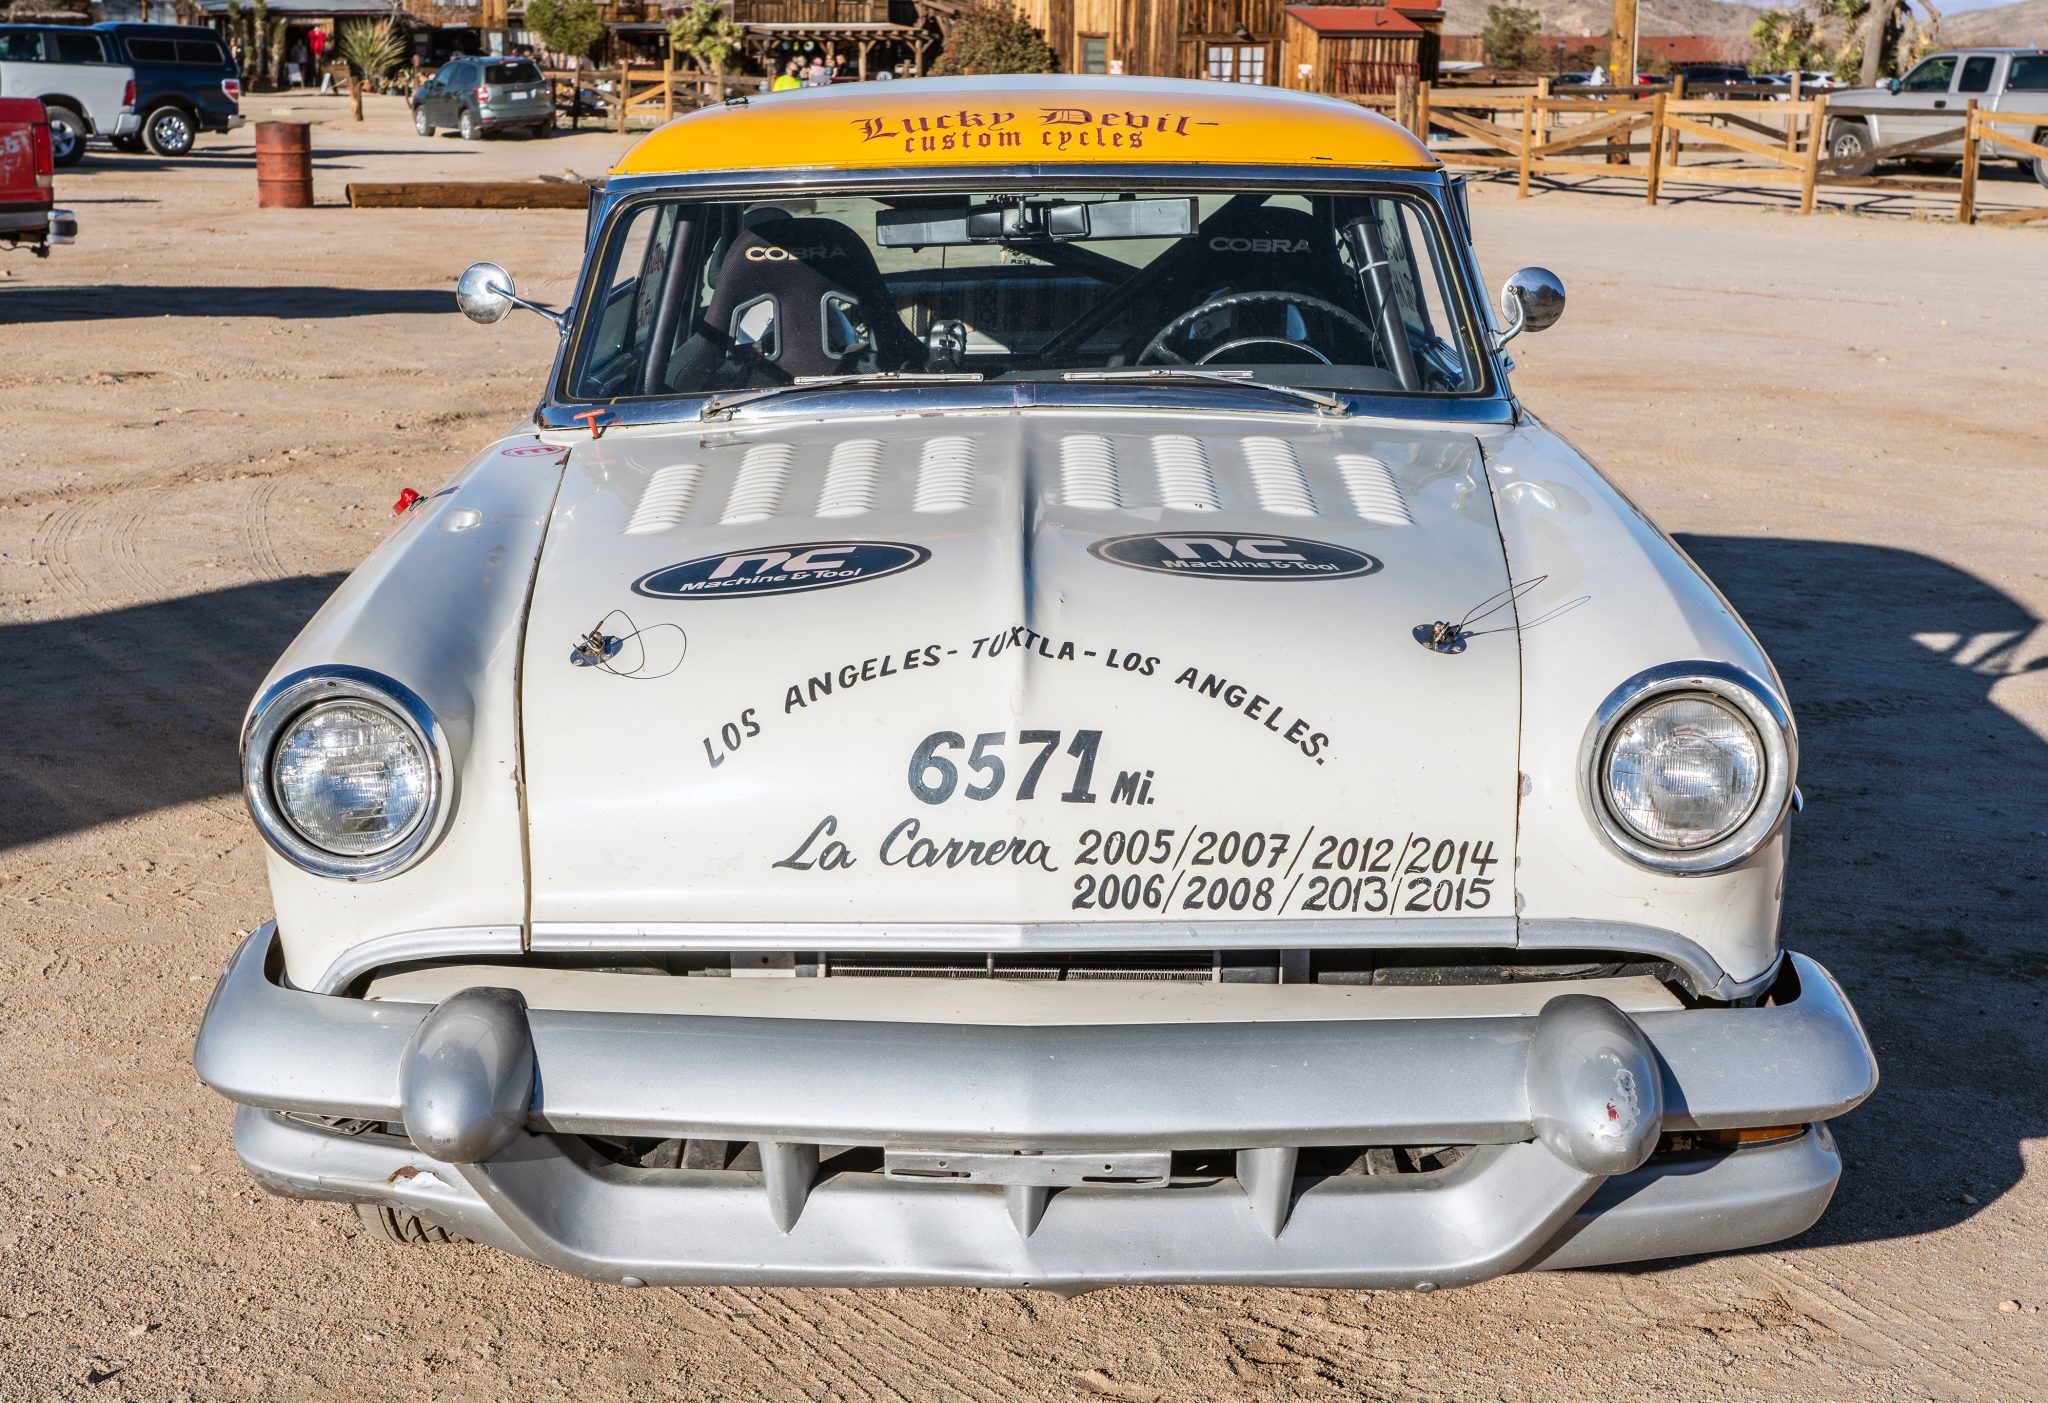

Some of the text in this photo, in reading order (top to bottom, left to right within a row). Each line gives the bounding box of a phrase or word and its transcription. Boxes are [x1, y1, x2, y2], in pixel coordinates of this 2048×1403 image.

[851, 110, 1015, 143] Lucky
[905, 127, 1144, 153] custom cycles
[1208, 236, 1313, 254] COBRA
[679, 567, 862, 592] Machine & Tool
[1162, 559, 1271, 570] Machine
[1290, 561, 1341, 572] Tool
[703, 707, 761, 769] LOS
[1175, 667, 1329, 766] ANGELES.
[908, 729, 1155, 806] 6571 Mi.
[772, 814, 857, 871] La
[879, 817, 1059, 872] Carrera
